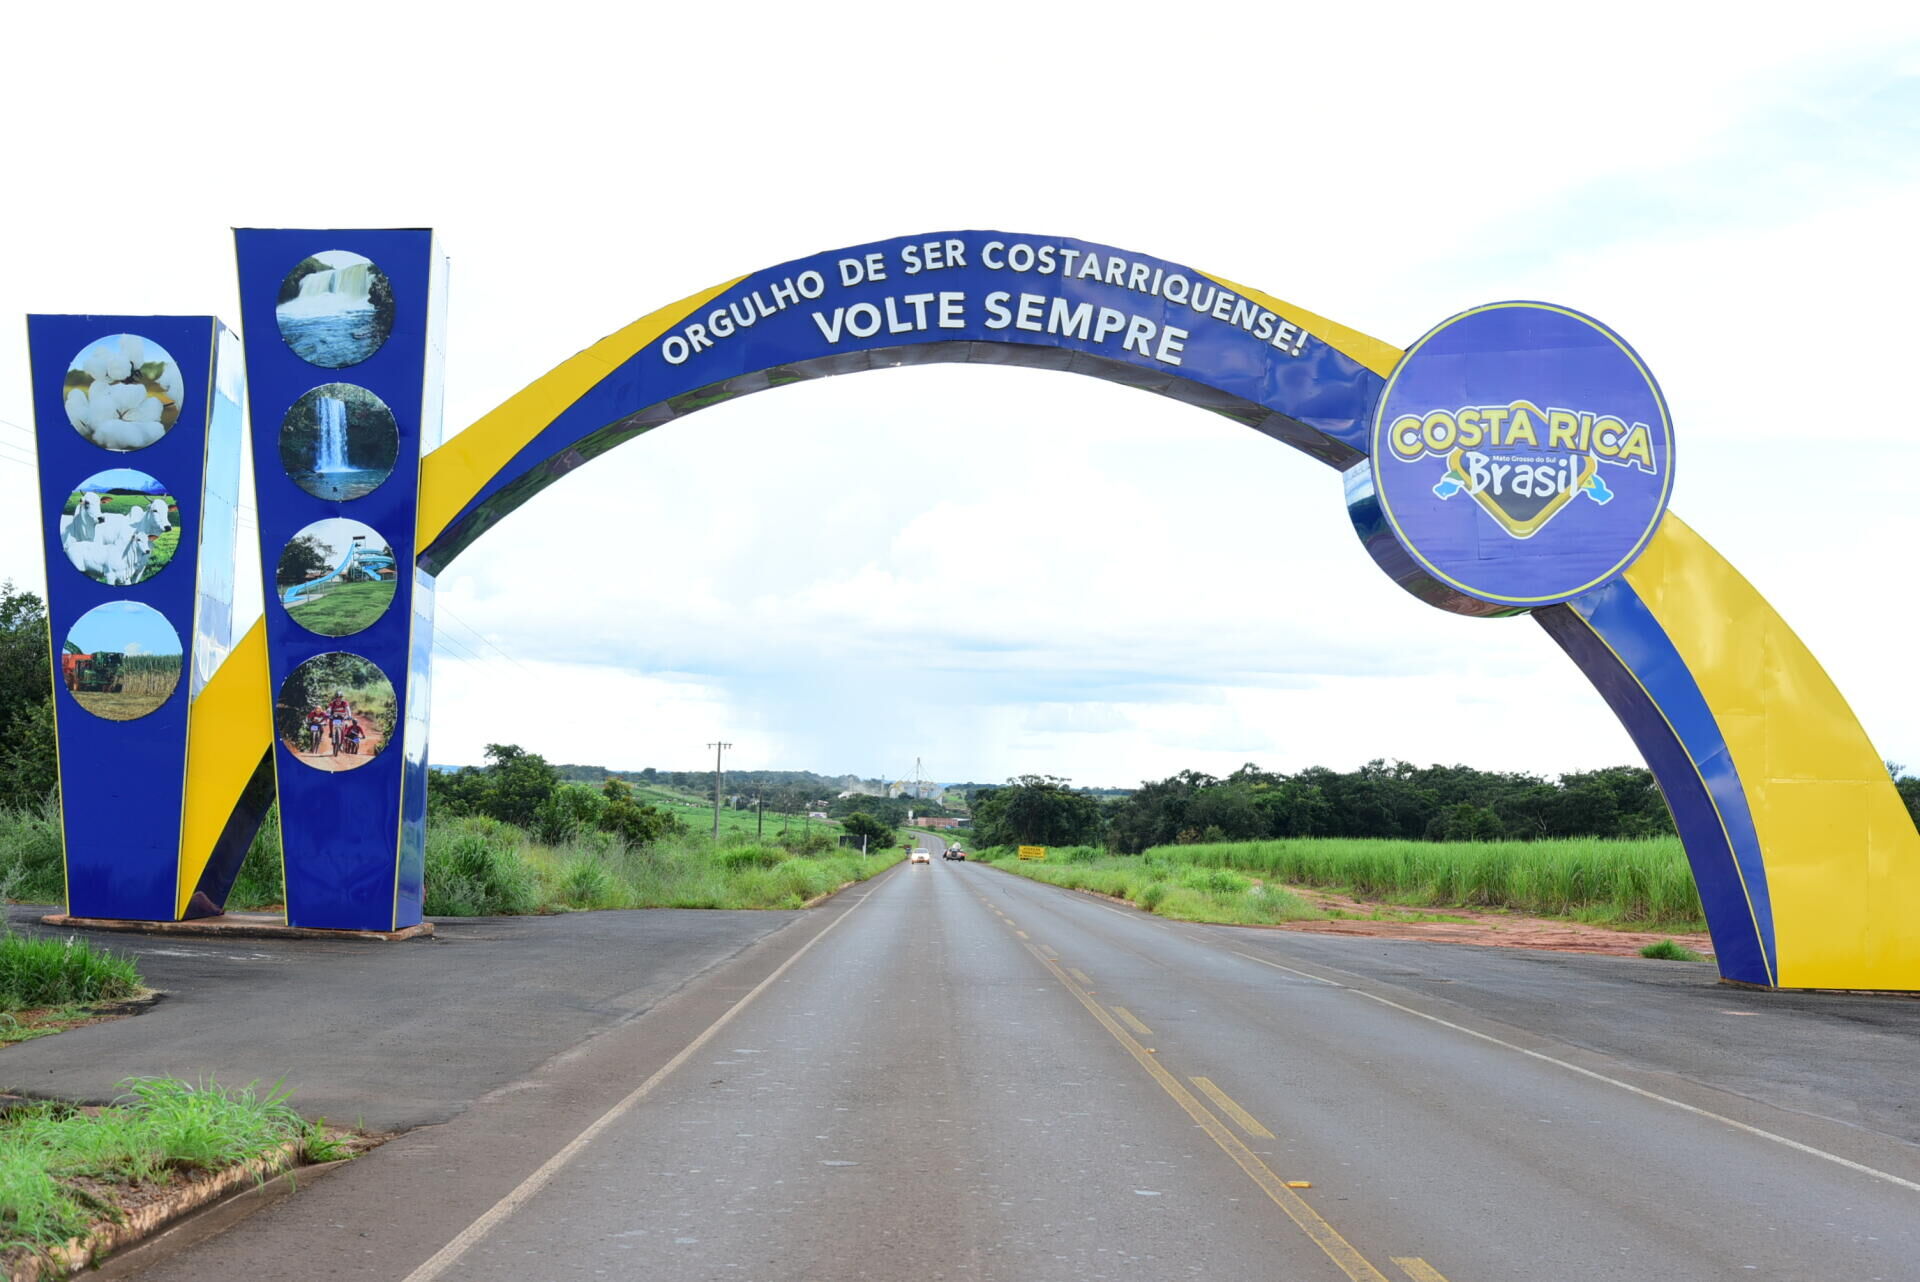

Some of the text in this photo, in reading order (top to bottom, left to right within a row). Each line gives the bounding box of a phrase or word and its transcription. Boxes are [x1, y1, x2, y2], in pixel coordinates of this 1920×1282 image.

[661, 239, 1309, 366] ORGULHO DE SER COSTARRIQUENSE!
[812, 291, 1189, 366] VOLTE SEMPRE
[1391, 409, 1653, 467] COSTA RICA
[1466, 452, 1579, 498] Brasil
